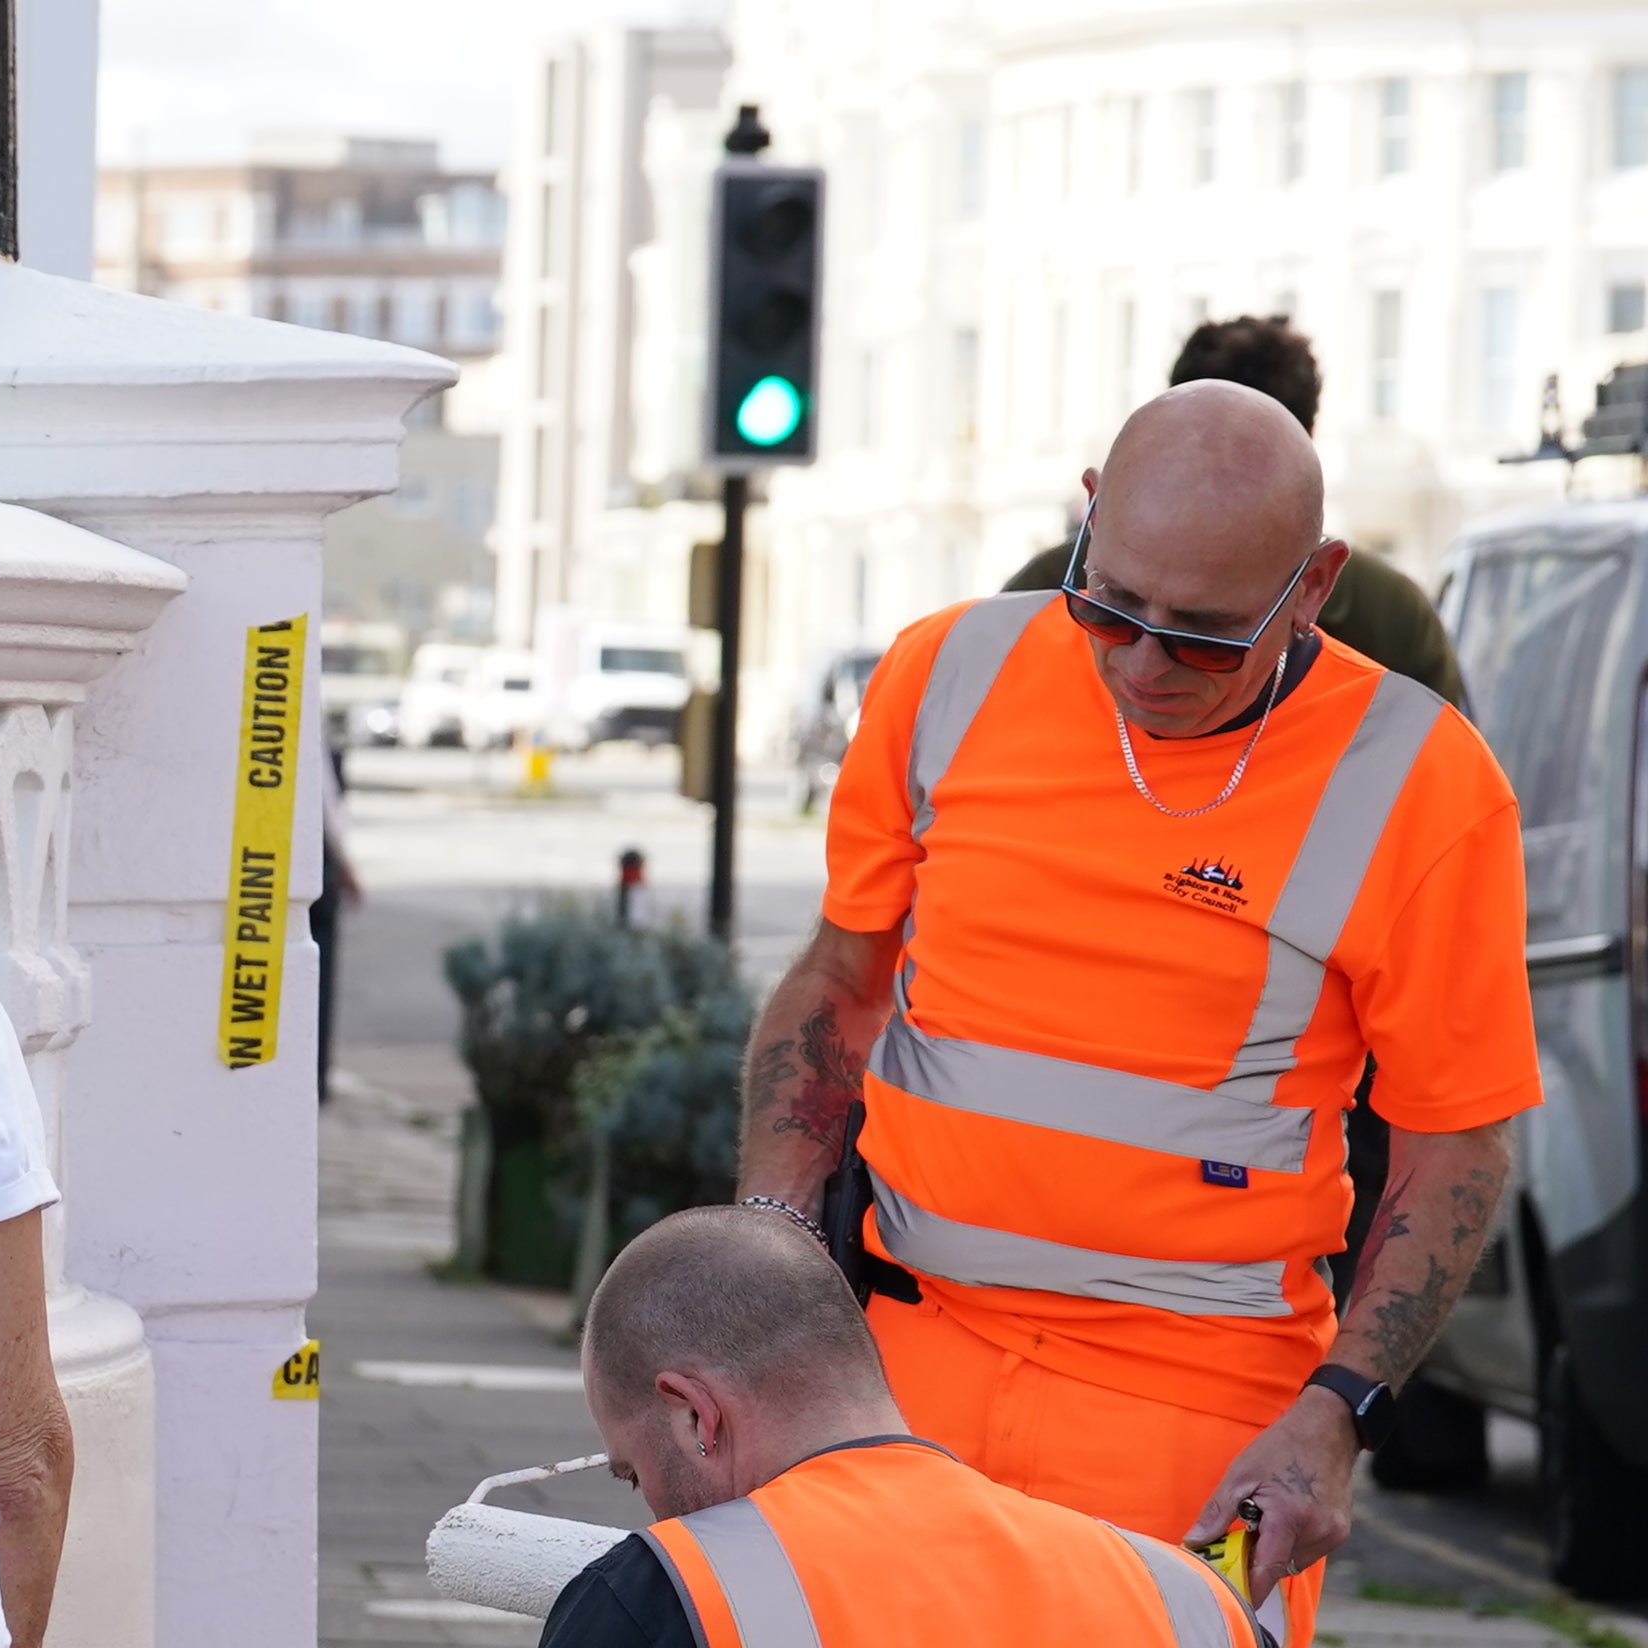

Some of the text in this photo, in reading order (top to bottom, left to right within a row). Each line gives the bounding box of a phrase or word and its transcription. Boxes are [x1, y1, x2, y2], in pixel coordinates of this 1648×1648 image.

[248, 646, 290, 789] CAUTION
[237, 847, 275, 943] PAINT
[1163, 872, 1249, 906] Brighton & Hove
[1163, 882, 1237, 914] City Council
[231, 953, 268, 1023] WET
